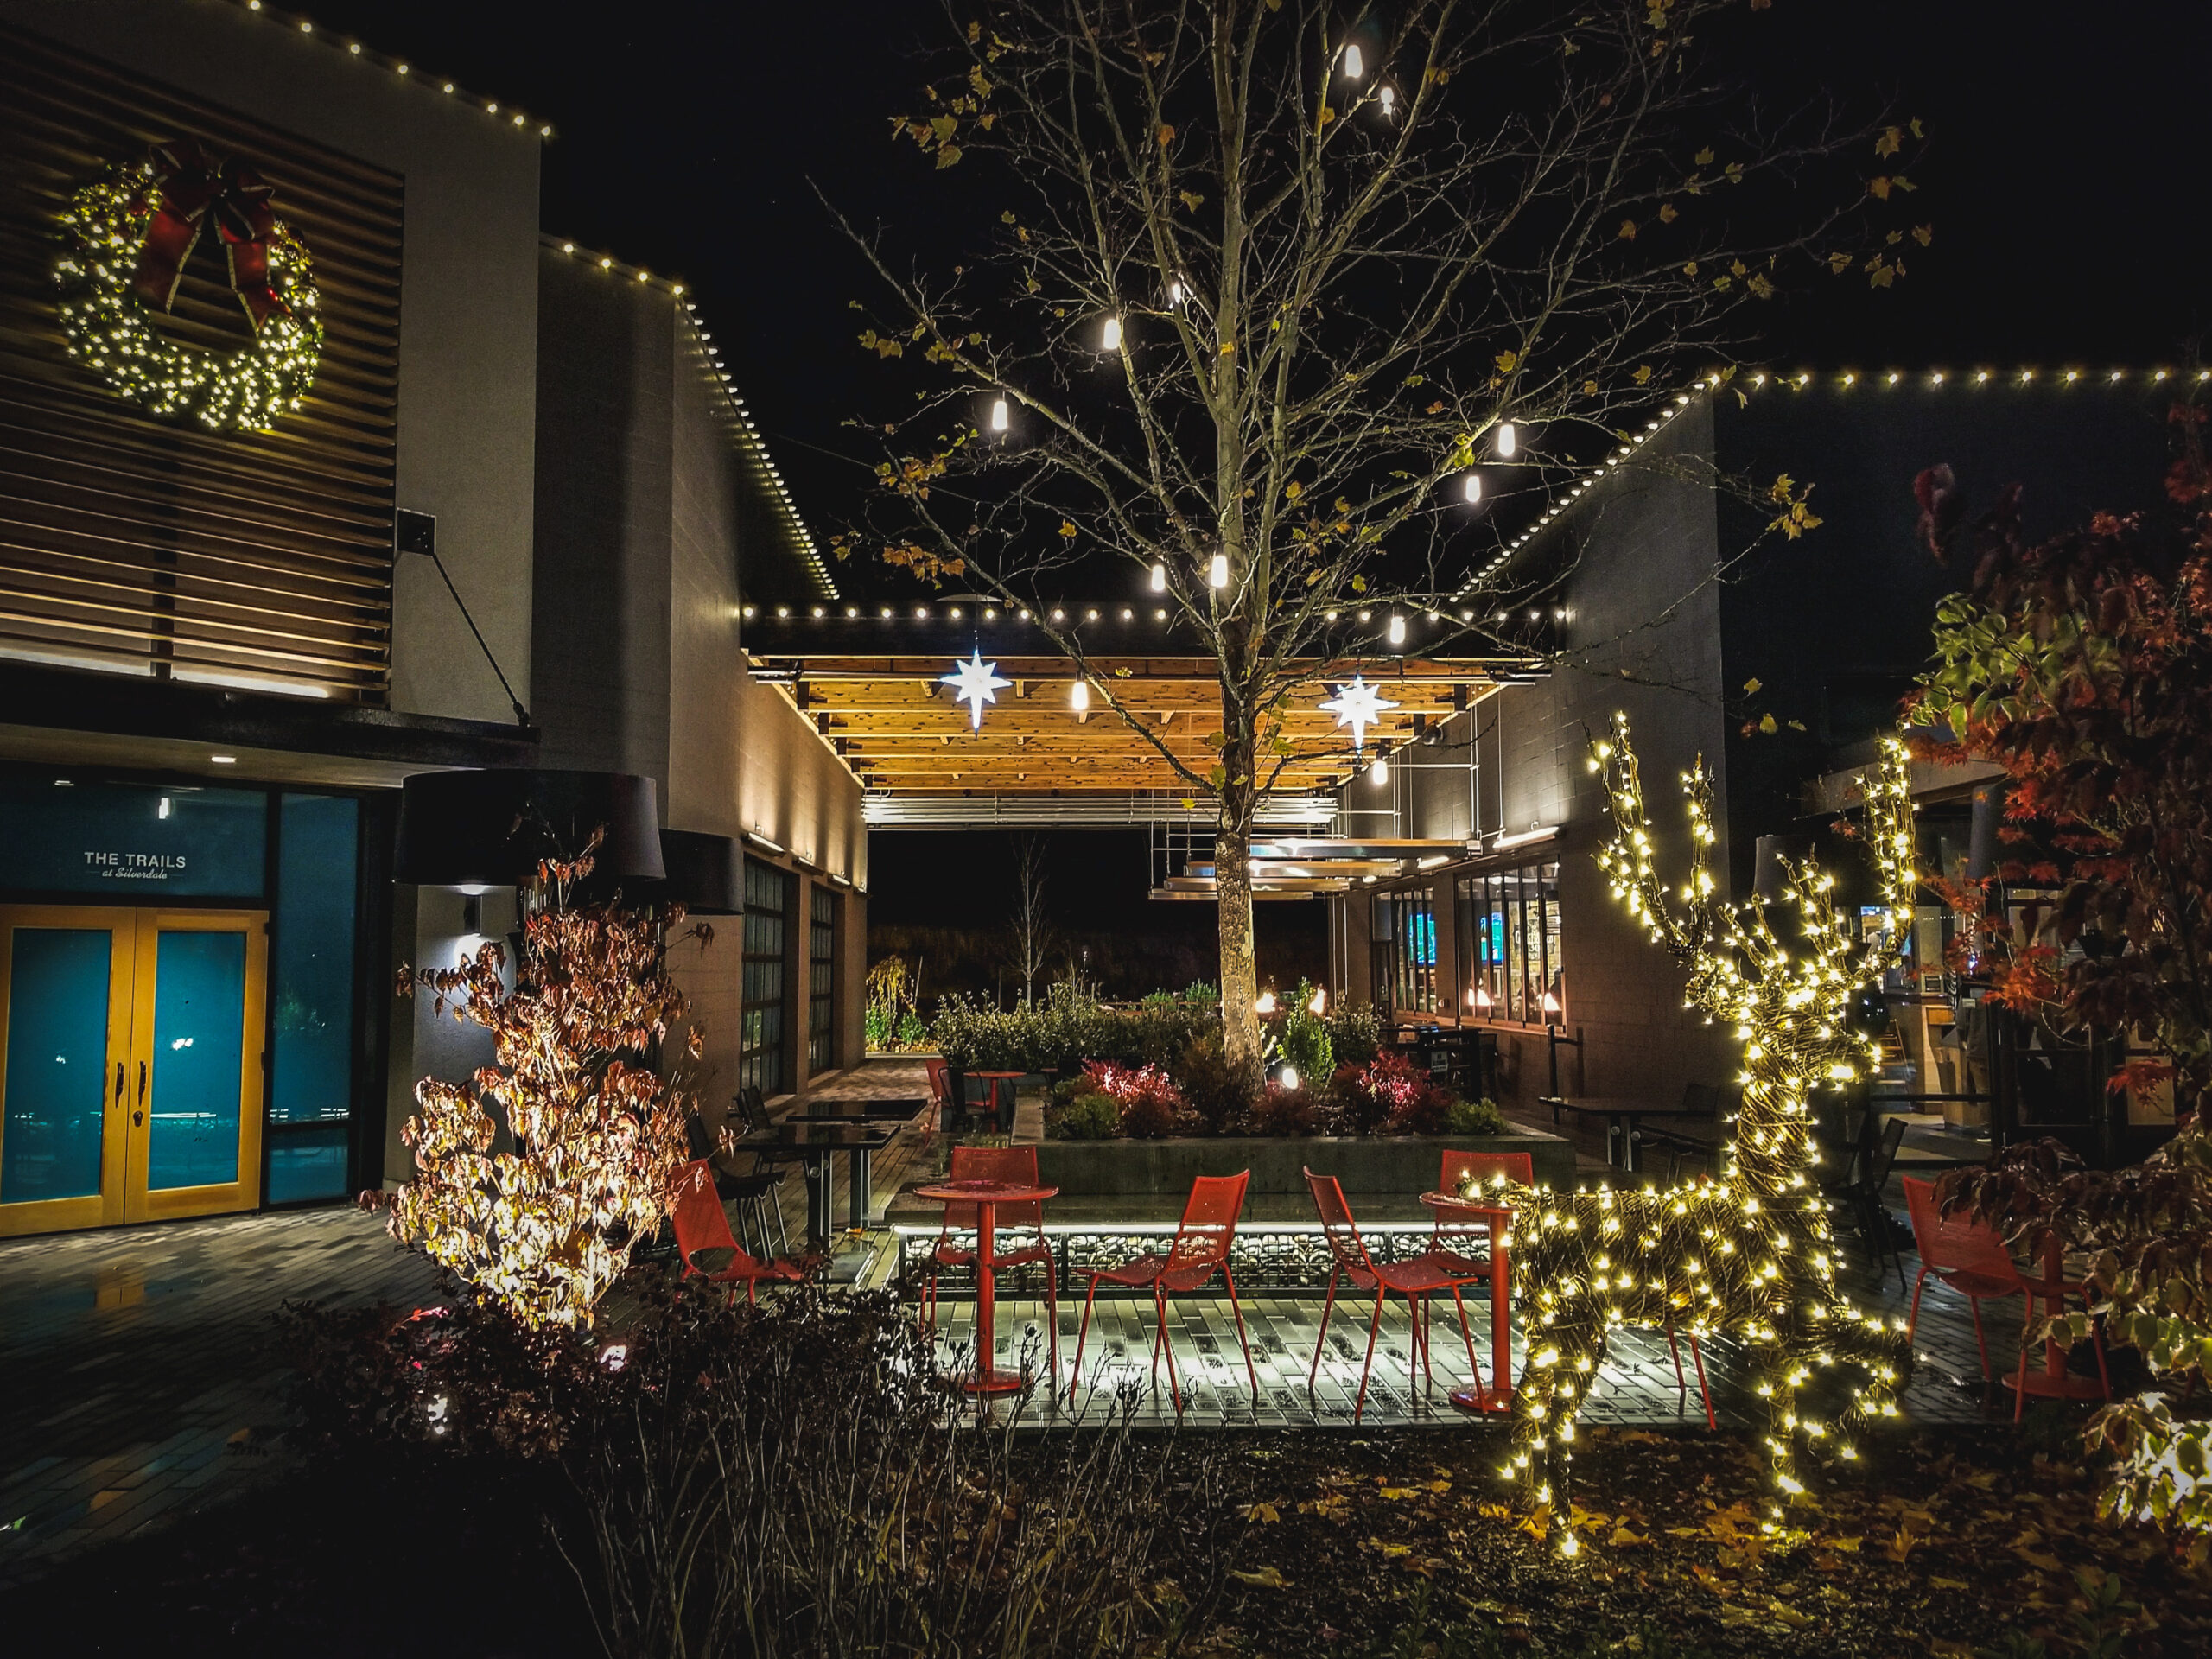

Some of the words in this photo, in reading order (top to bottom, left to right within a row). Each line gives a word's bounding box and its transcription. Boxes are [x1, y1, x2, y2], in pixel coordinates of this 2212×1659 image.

[84, 852, 119, 865] THE
[125, 854, 186, 868] TRAILS
[115, 867, 168, 880] Silverdale
